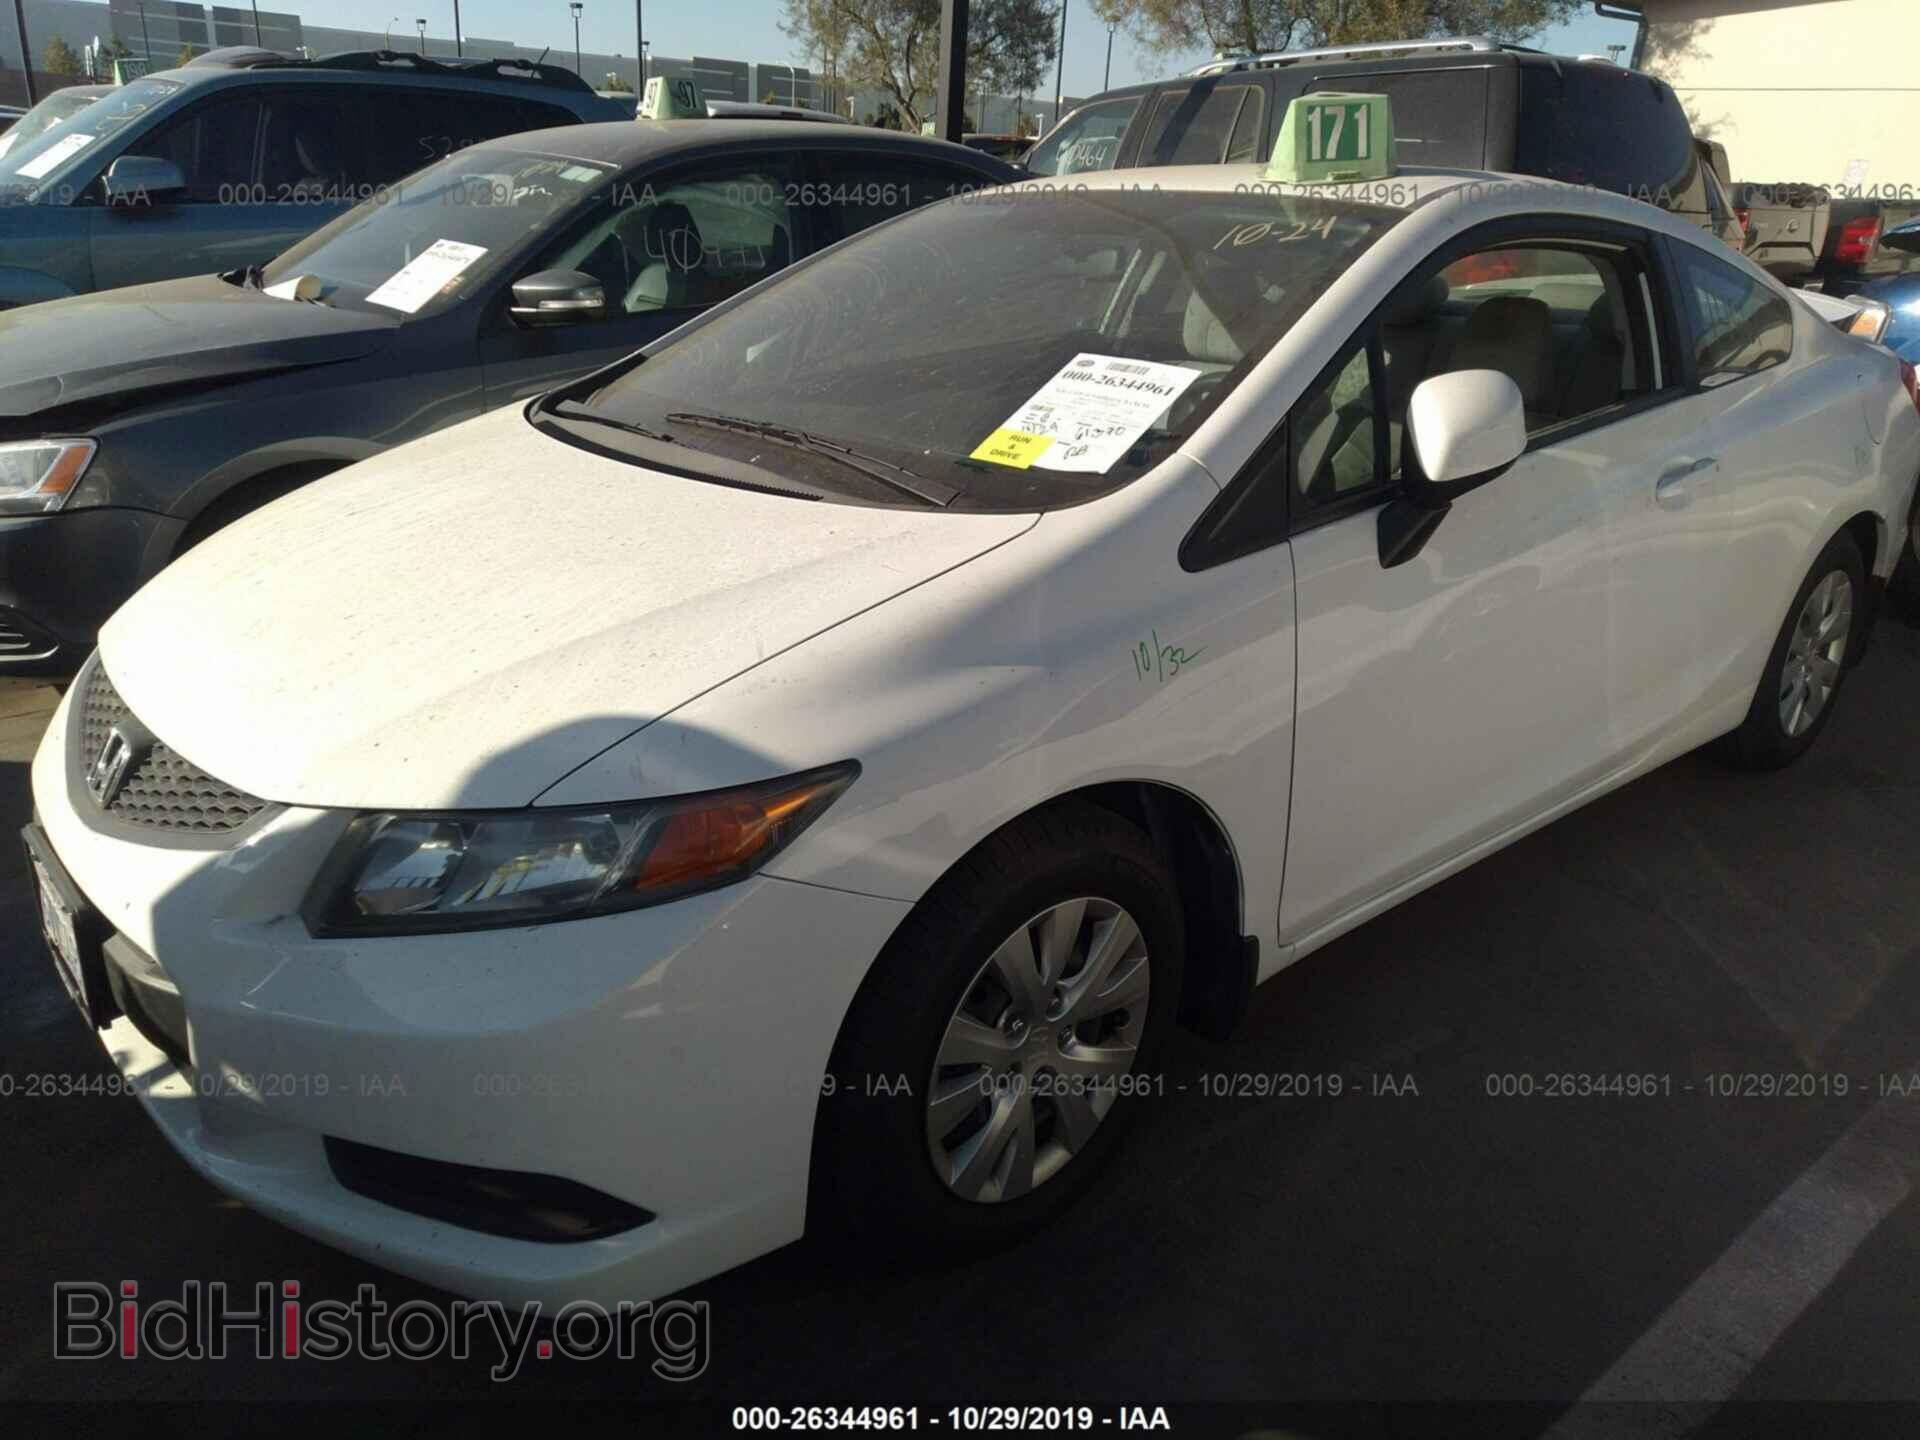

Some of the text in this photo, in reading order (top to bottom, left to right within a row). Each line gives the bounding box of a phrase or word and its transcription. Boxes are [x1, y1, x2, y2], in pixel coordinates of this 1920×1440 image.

[678, 80, 697, 109] 97
[1307, 104, 1368, 161] 171
[1062, 369, 1175, 397] 000-26344961
